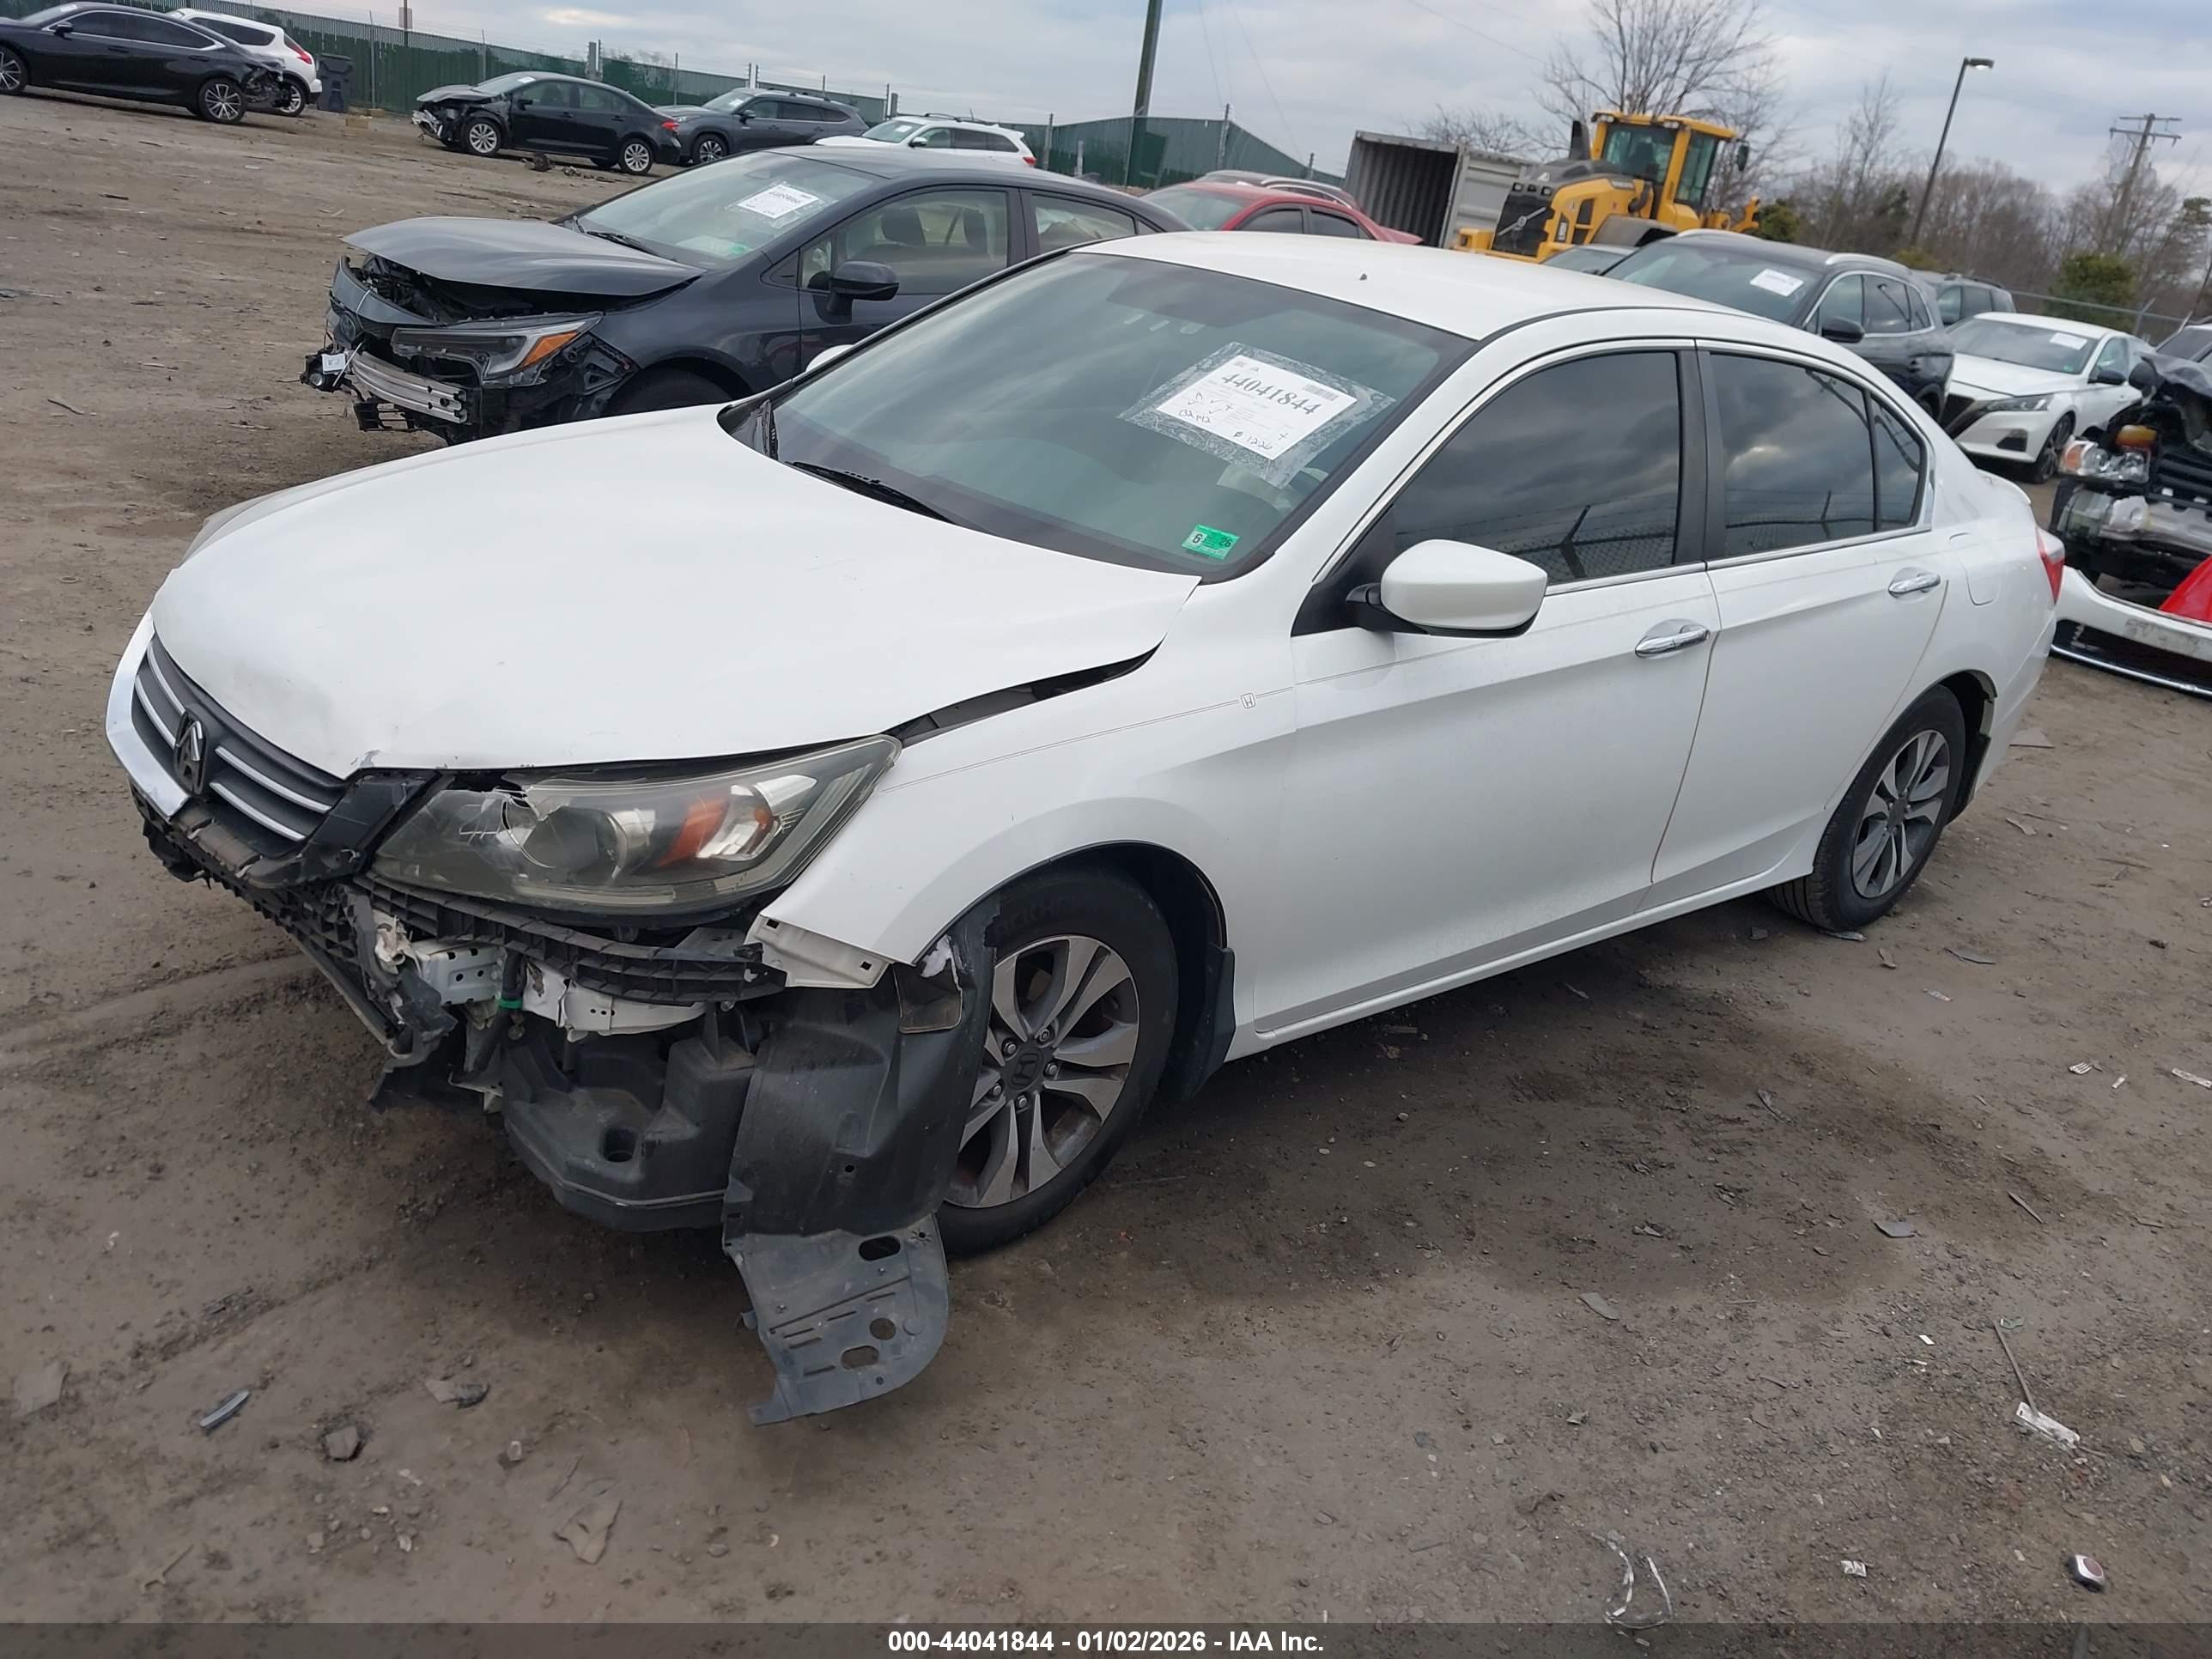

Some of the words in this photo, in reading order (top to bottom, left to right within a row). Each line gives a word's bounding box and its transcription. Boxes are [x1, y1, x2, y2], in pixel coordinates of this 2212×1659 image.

[1222, 374, 1322, 416] 44041844
[1192, 533, 1204, 544] 6
[1218, 537, 1234, 548] 26
